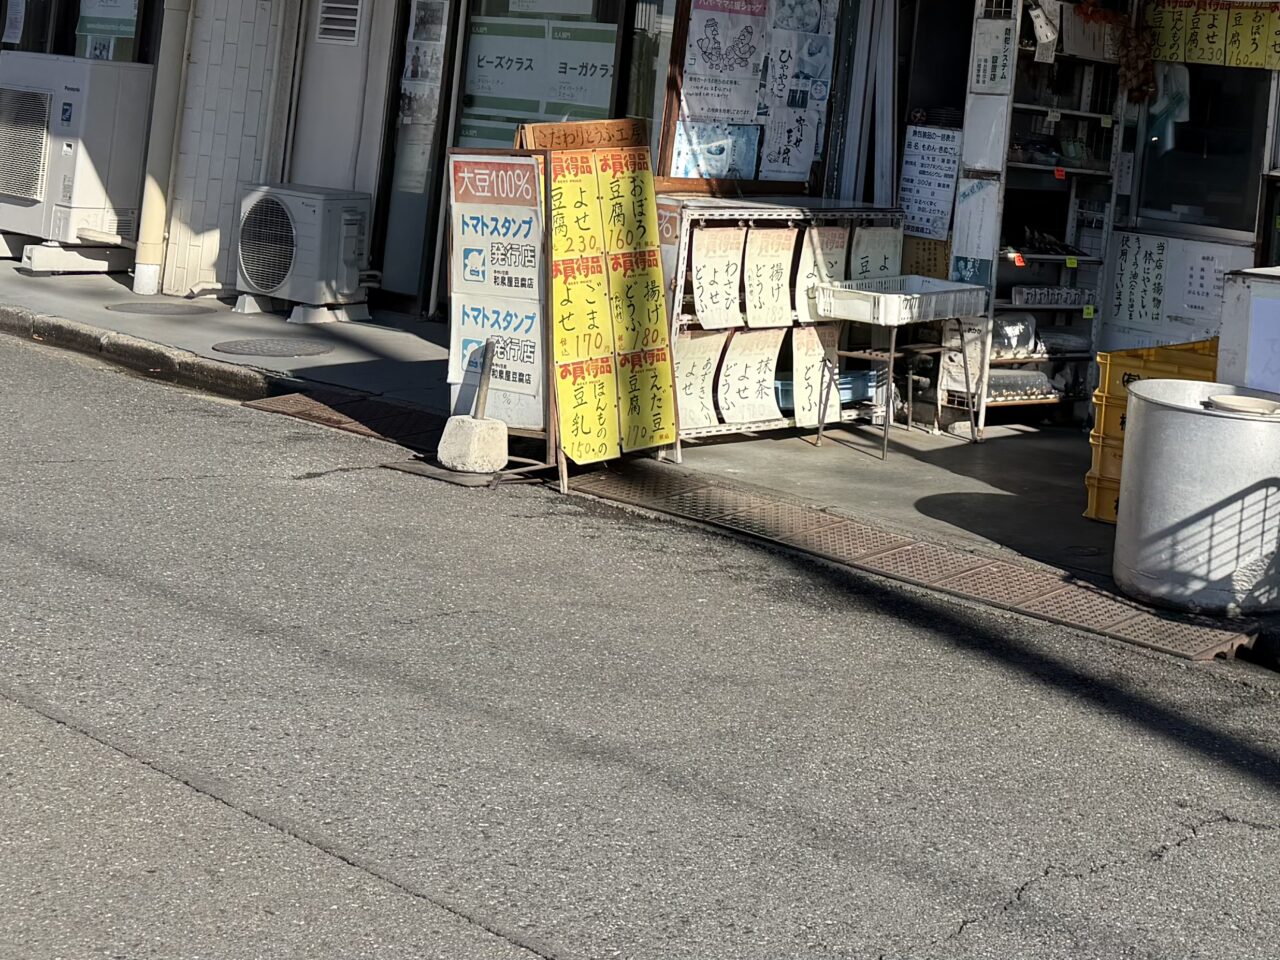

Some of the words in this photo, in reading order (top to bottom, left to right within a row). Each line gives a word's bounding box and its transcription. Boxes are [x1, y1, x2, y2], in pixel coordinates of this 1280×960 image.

[1206, 13, 1219, 45] よせ
[1250, 10, 1265, 54] おぼろ
[476, 54, 534, 72] ビーズクラス
[458, 167, 532, 200] 大豆100%
[600, 152, 649, 179] お買得品
[552, 186, 569, 238] 豆腐
[573, 186, 592, 231] よせ
[608, 178, 626, 228] 豆腐
[629, 176, 648, 240] おぼろ
[461, 213, 533, 239] トマトスタンプ
[490, 242, 536, 268] 発行店
[611, 249, 659, 279] お買得品
[1113, 235, 1131, 317] 使用しています
[493, 275, 534, 289] 和泉屋豆腐店
[643, 279, 662, 326] 揚げ
[696, 263, 708, 313] どうふ
[709, 267, 720, 305] よせ
[723, 260, 738, 310] わさび
[754, 263, 766, 310] どうふ
[769, 262, 784, 303] 揚げ
[1138, 250, 1156, 319] 体にやさしい
[1151, 242, 1166, 321] 当店の揚物は
[461, 303, 537, 335] トマトスタンプ
[558, 285, 576, 332] よせ
[585, 282, 602, 331] ごま
[625, 280, 641, 333] どうふ
[559, 356, 613, 386] お買得品
[619, 347, 667, 374] お買得品
[682, 361, 698, 396] よせ
[736, 363, 751, 400] よせ
[755, 356, 774, 400] 抹茶
[627, 374, 641, 417] 豆腐
[650, 371, 667, 434] えだ豆
[721, 363, 738, 411] どうふ
[801, 364, 818, 413] どうふ
[571, 386, 592, 438] 豆乳
[593, 381, 608, 456] ほんものの
